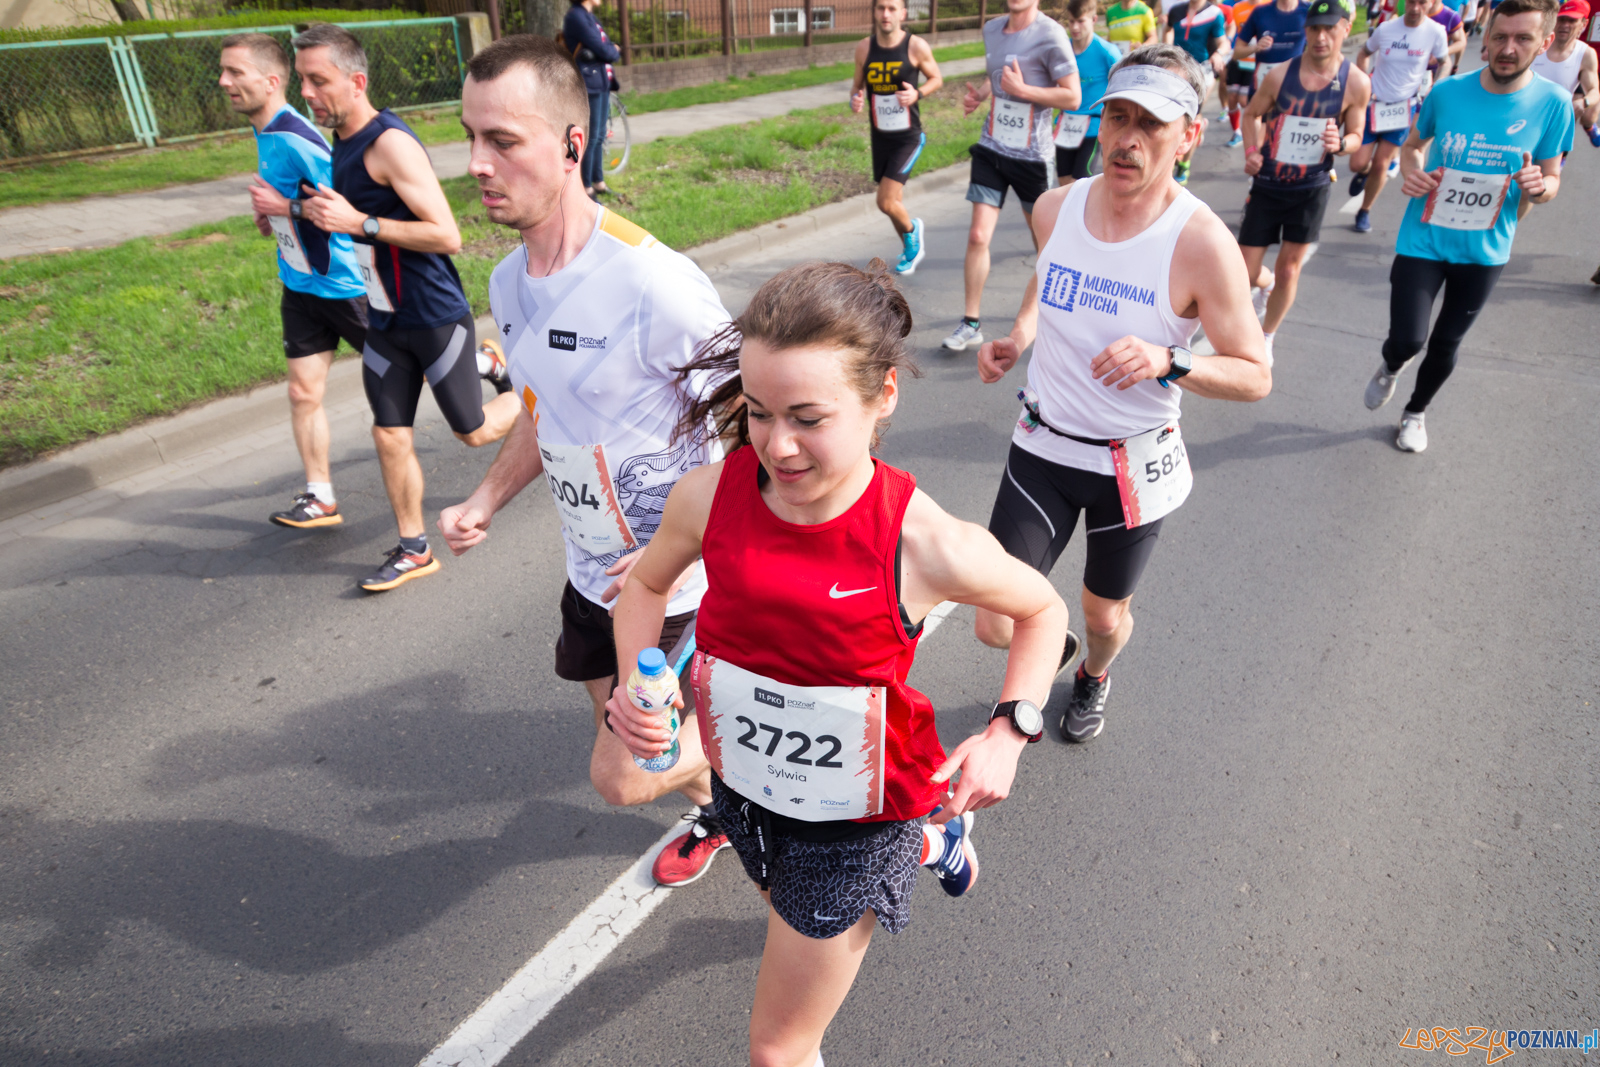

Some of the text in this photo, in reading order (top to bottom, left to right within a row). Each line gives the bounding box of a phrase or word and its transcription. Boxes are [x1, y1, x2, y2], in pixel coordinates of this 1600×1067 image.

[996, 113, 1024, 129] 4563
[1379, 106, 1405, 117] 9350
[1289, 132, 1320, 145] 1199
[1467, 150, 1503, 160] PHILIPS
[1444, 188, 1493, 207] 2100
[1083, 273, 1155, 307] MUROWANA
[1079, 291, 1118, 316] DYCHA
[735, 715, 843, 769] 2722
[767, 764, 807, 783] Sylwia
